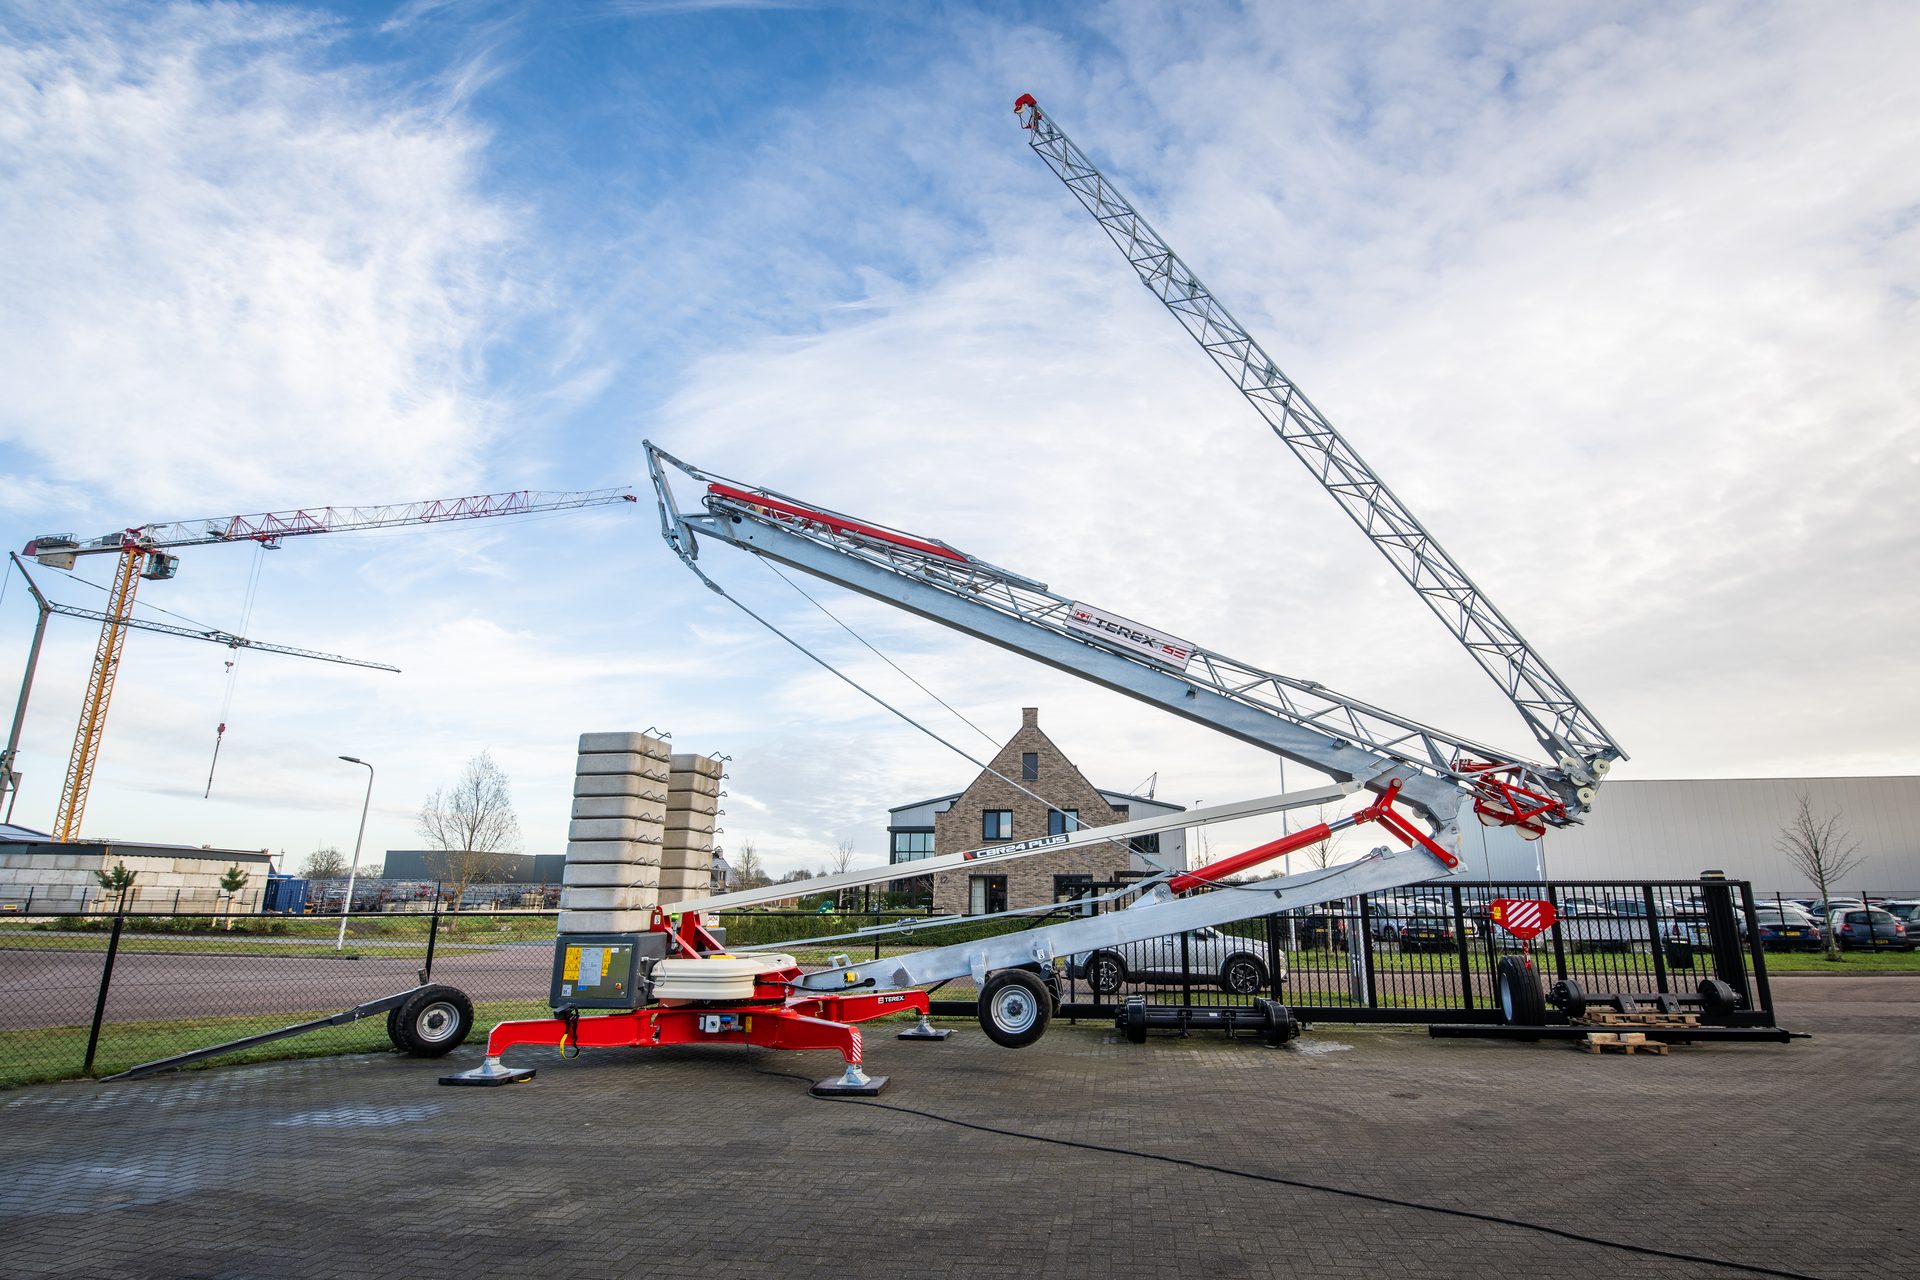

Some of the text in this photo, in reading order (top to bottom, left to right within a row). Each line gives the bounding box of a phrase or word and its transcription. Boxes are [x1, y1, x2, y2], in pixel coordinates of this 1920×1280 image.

[1095, 617, 1156, 648] TEREX
[976, 835, 1067, 858] CBR24 PLUS
[885, 995, 905, 1003] TEREX
